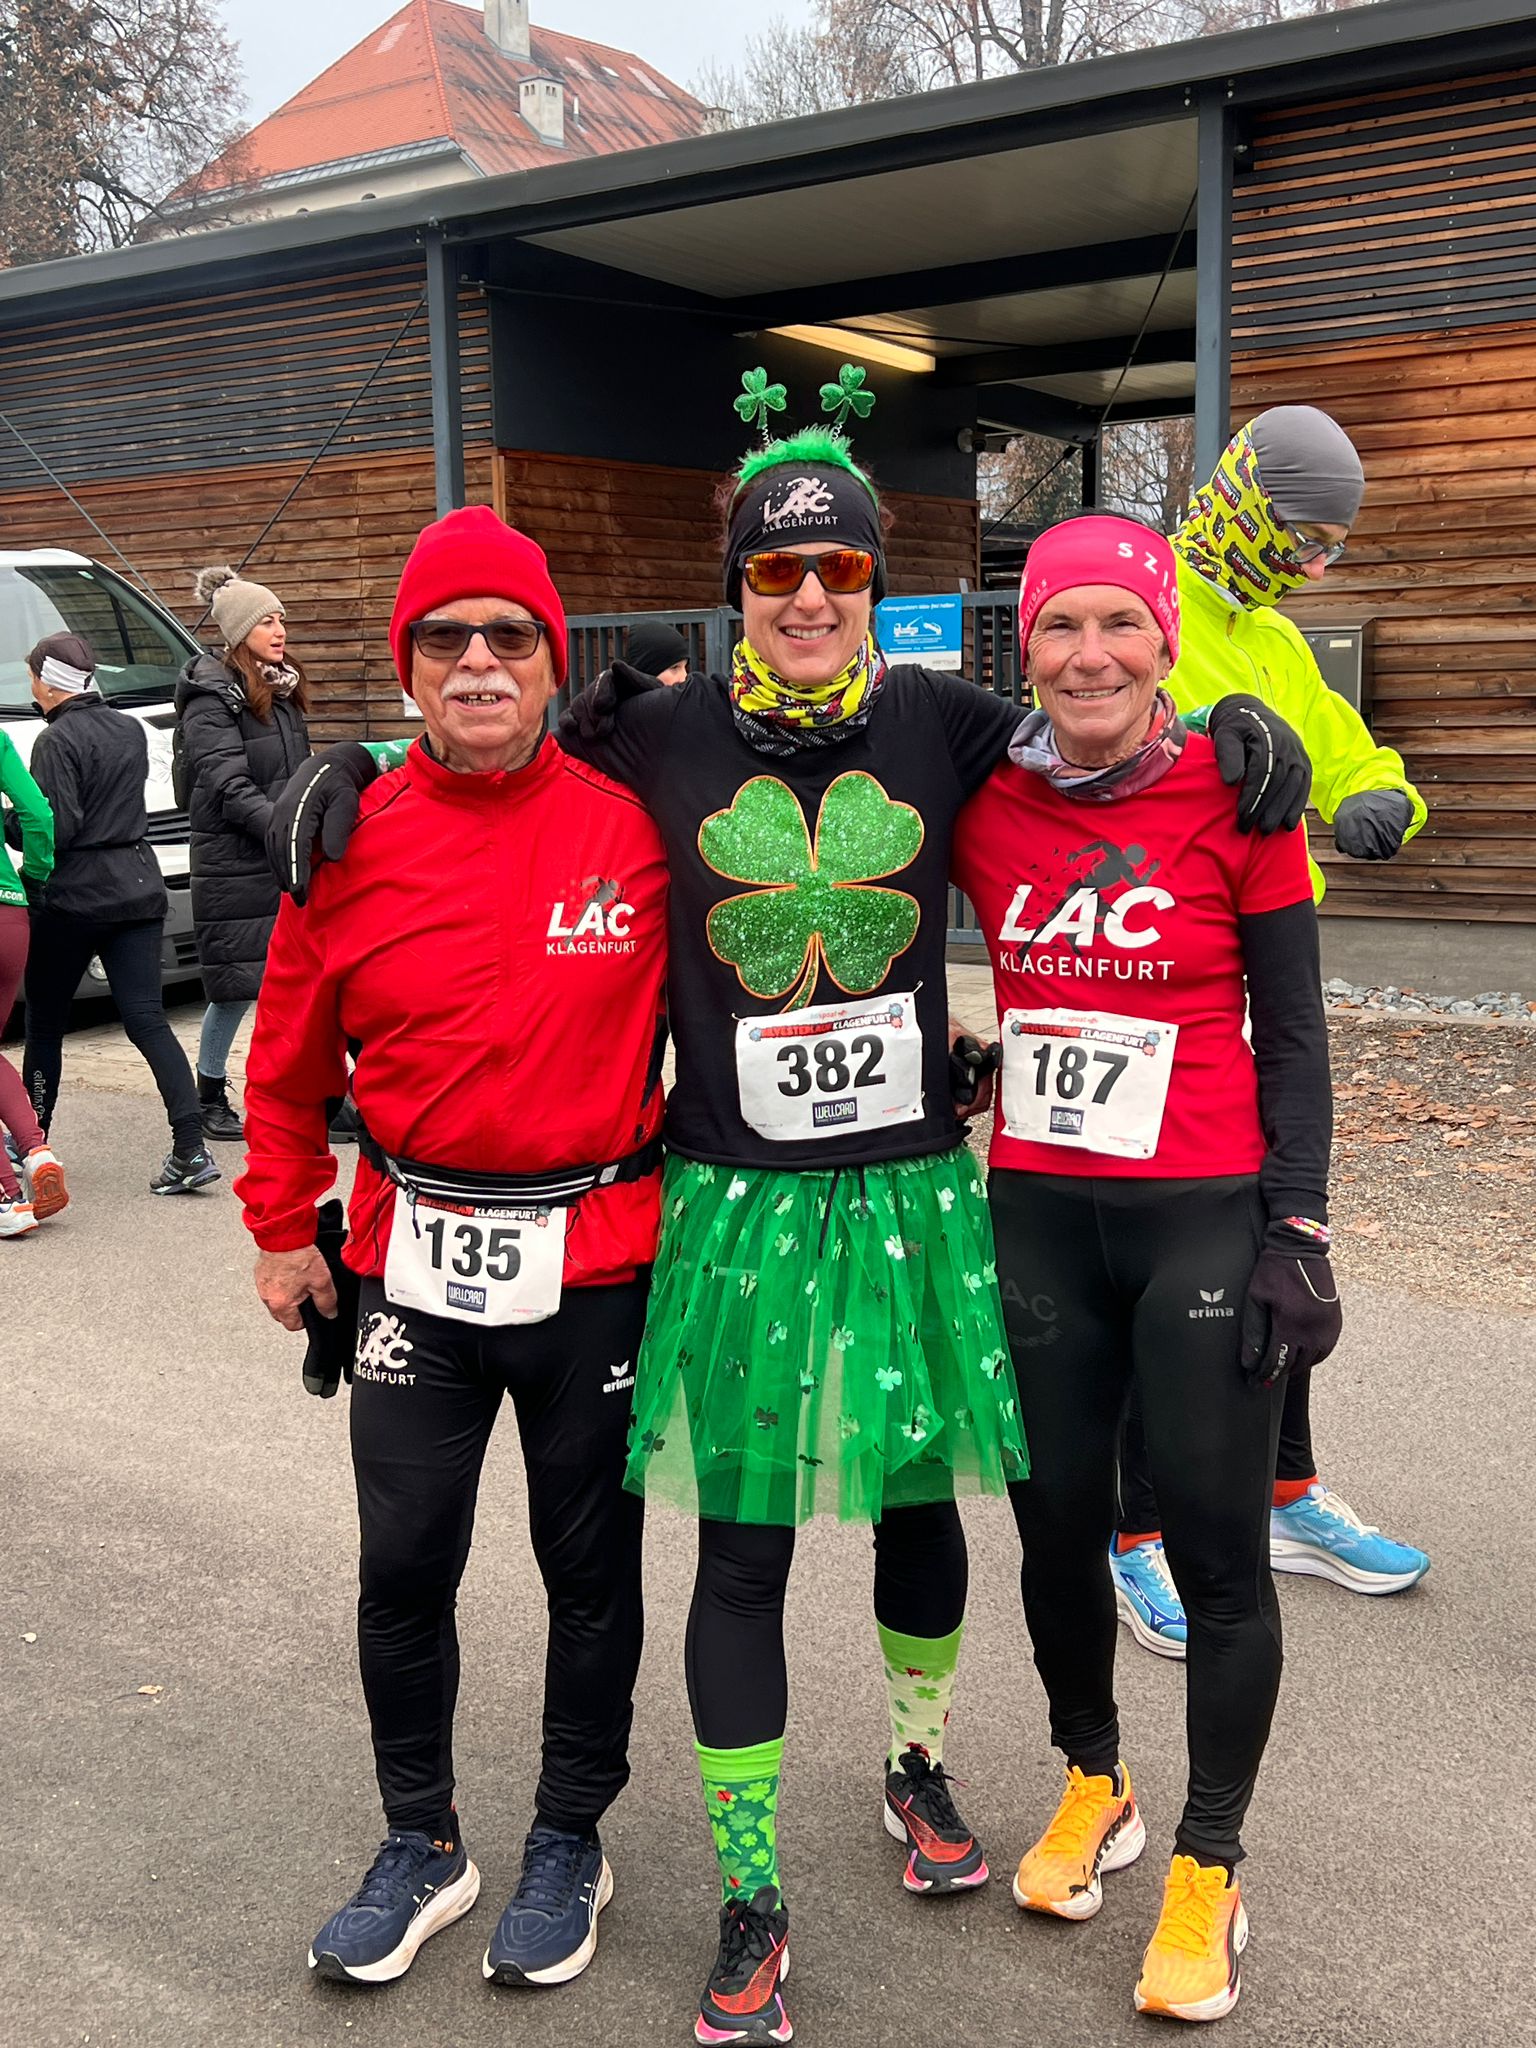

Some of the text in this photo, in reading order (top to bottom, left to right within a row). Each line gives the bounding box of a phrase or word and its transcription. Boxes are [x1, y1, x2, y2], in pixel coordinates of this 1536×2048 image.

[763, 490, 834, 525] LAC
[762, 516, 838, 533] KLGENFURT
[546, 902, 636, 937] LAC
[998, 885, 1176, 949] LAC
[546, 940, 637, 955] KLAGENFURT
[1000, 951, 1176, 981] KLAGENFURT
[833, 1013, 891, 1031] KLAGENFURT
[1080, 1028, 1145, 1048] KLAGENFURT
[776, 1034, 887, 1097] 382
[1033, 1043, 1130, 1105] 187
[814, 1101, 856, 1120] WELLCARD
[474, 1206, 538, 1221] KLAGENFURT
[424, 1217, 522, 1281] 135
[448, 1284, 485, 1305] WELLCARD
[1002, 1278, 1058, 1322] AC
[1189, 1306, 1234, 1319] erima
[355, 1366, 417, 1386] GENFURT
[603, 1376, 635, 1393] erima
